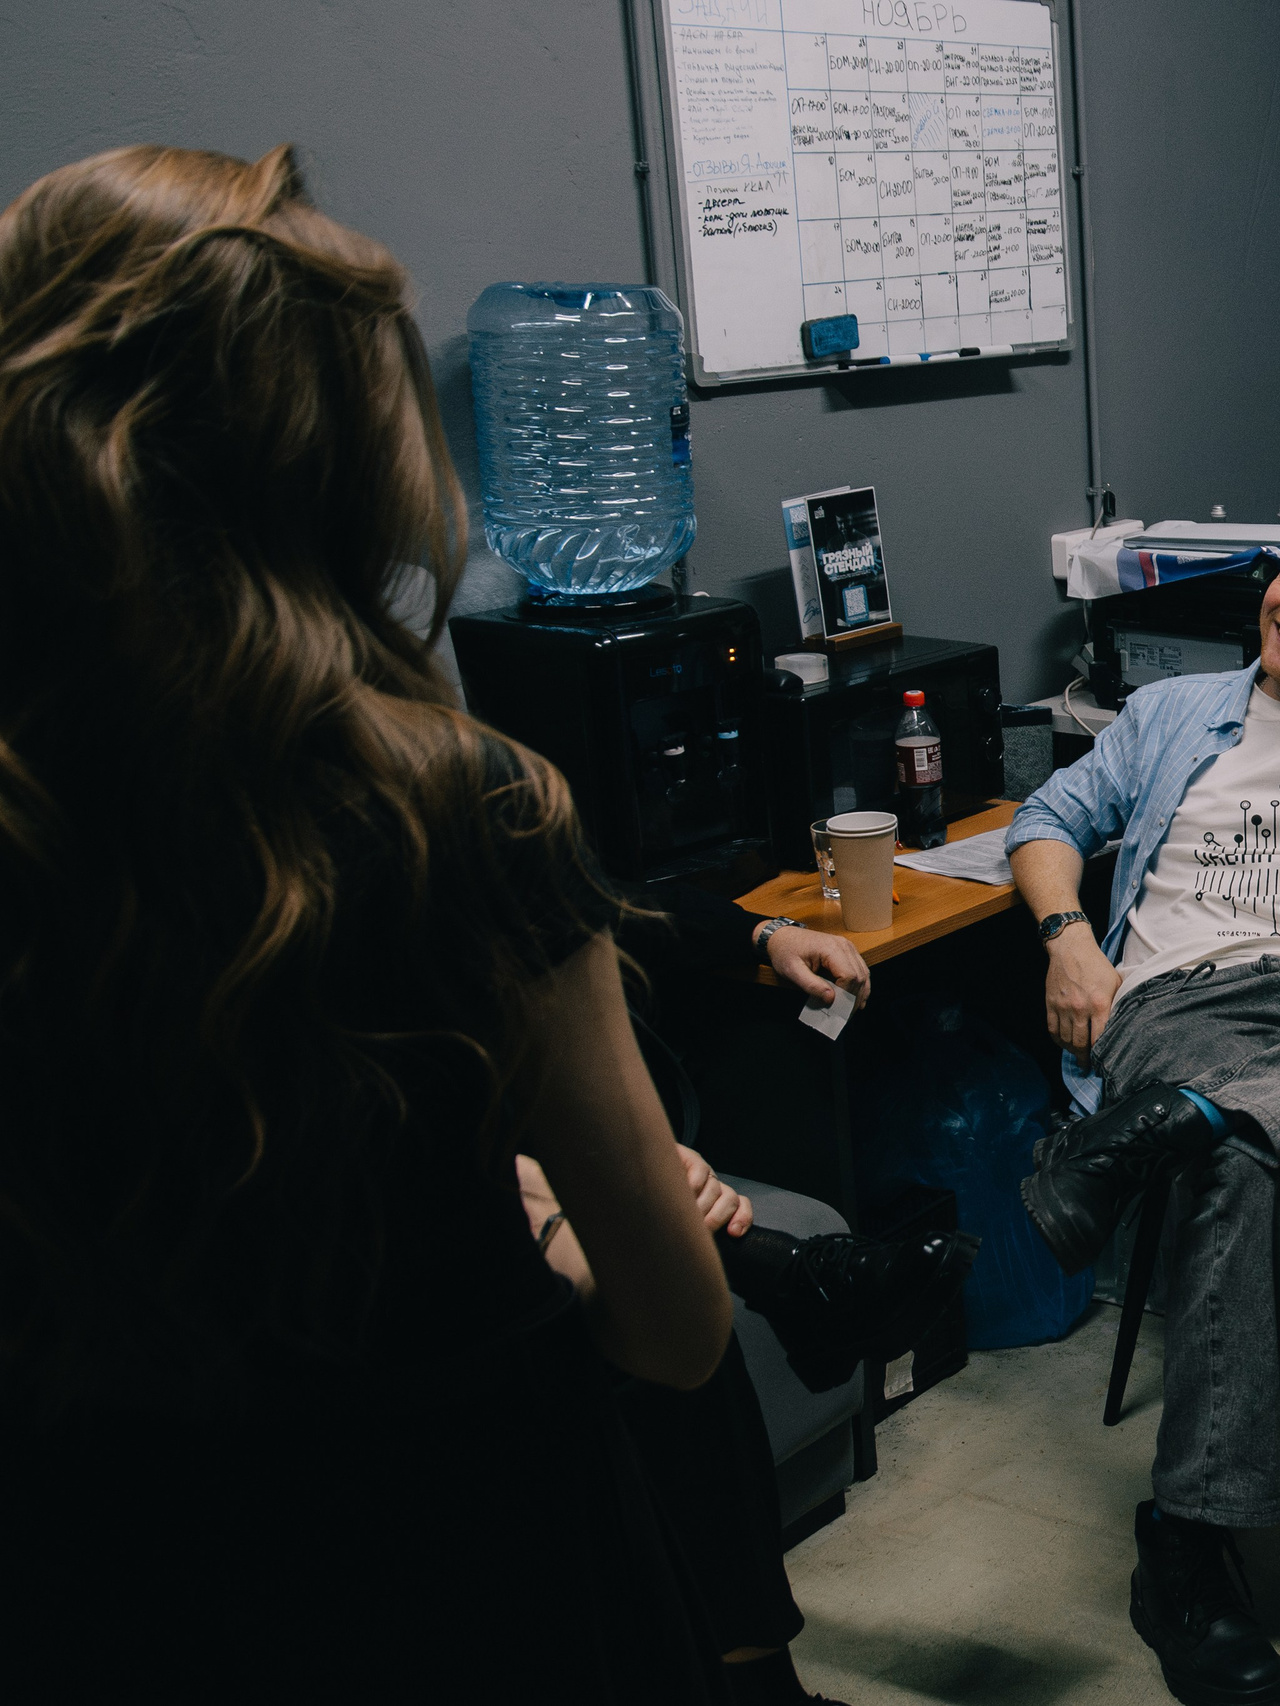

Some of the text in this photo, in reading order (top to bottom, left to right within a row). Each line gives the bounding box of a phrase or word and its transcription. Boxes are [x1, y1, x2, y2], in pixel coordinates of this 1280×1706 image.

[863, 0, 967, 34] НОЯБРЬ
[822, 542, 873, 564] ГРЯЗНЫЙ
[824, 556, 875, 575] СТЕНДАП
